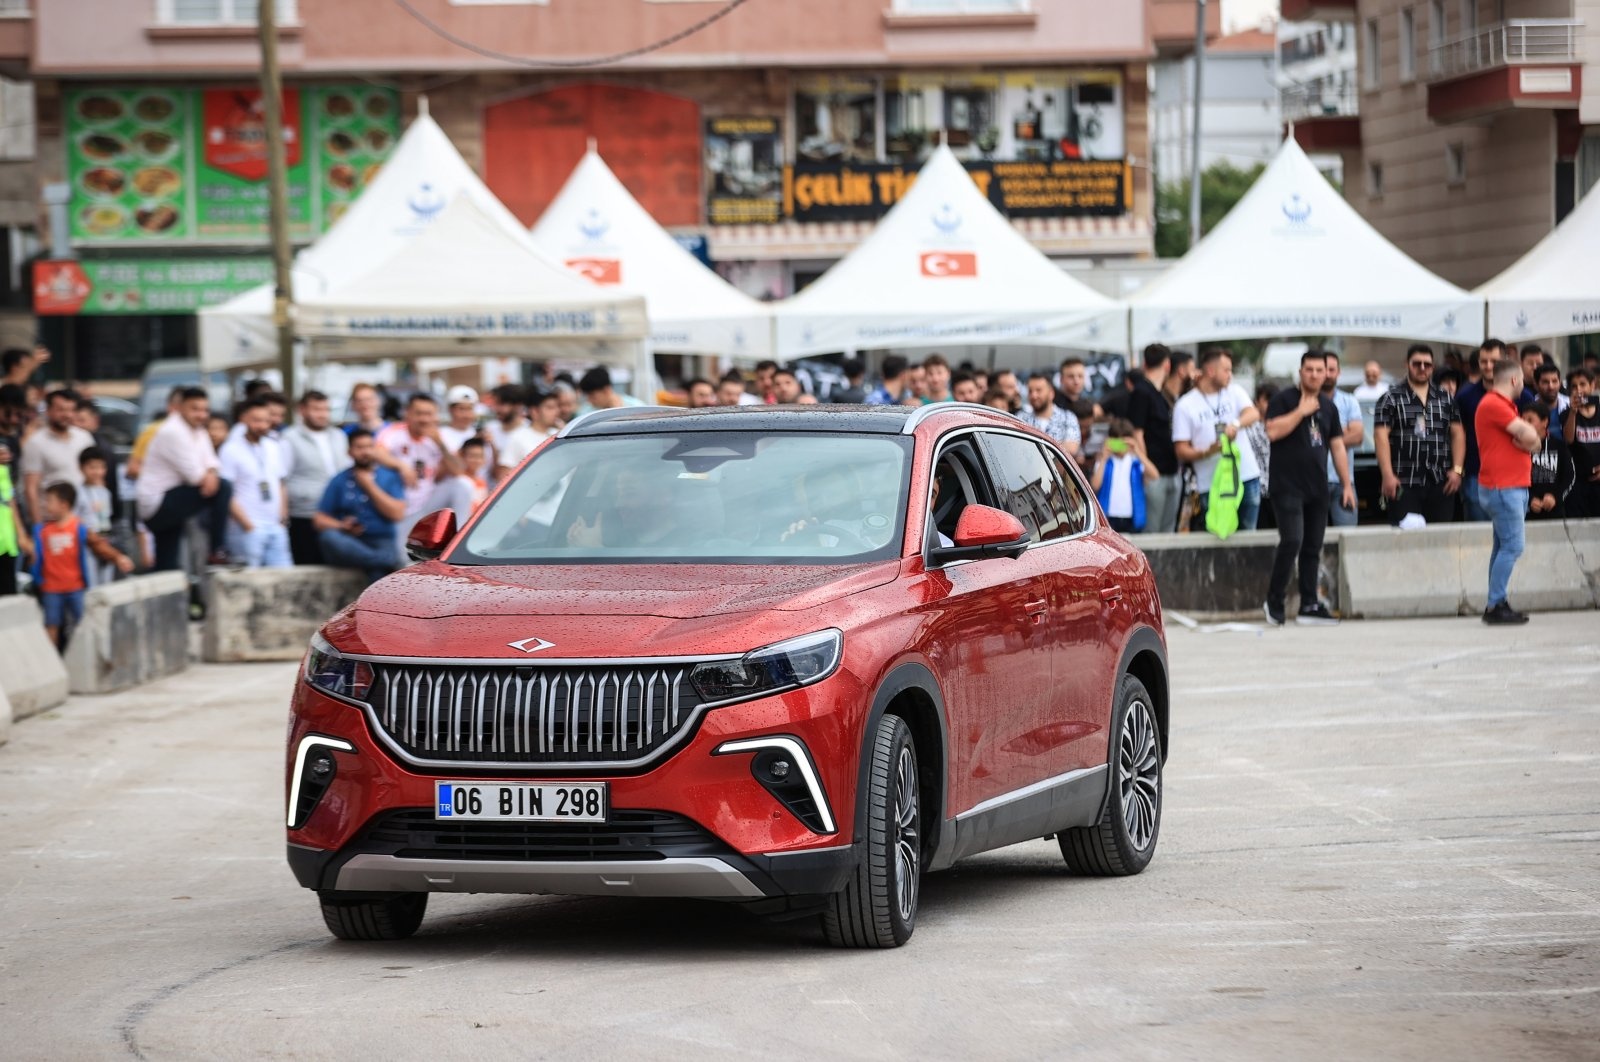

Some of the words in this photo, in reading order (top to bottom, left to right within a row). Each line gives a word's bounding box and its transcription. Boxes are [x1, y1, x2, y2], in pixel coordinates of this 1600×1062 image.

[796, 167, 873, 210] ÇELİK
[439, 803, 451, 812] TR
[454, 788, 482, 815] 06
[499, 788, 543, 815] BIN
[556, 789, 599, 816] 298
